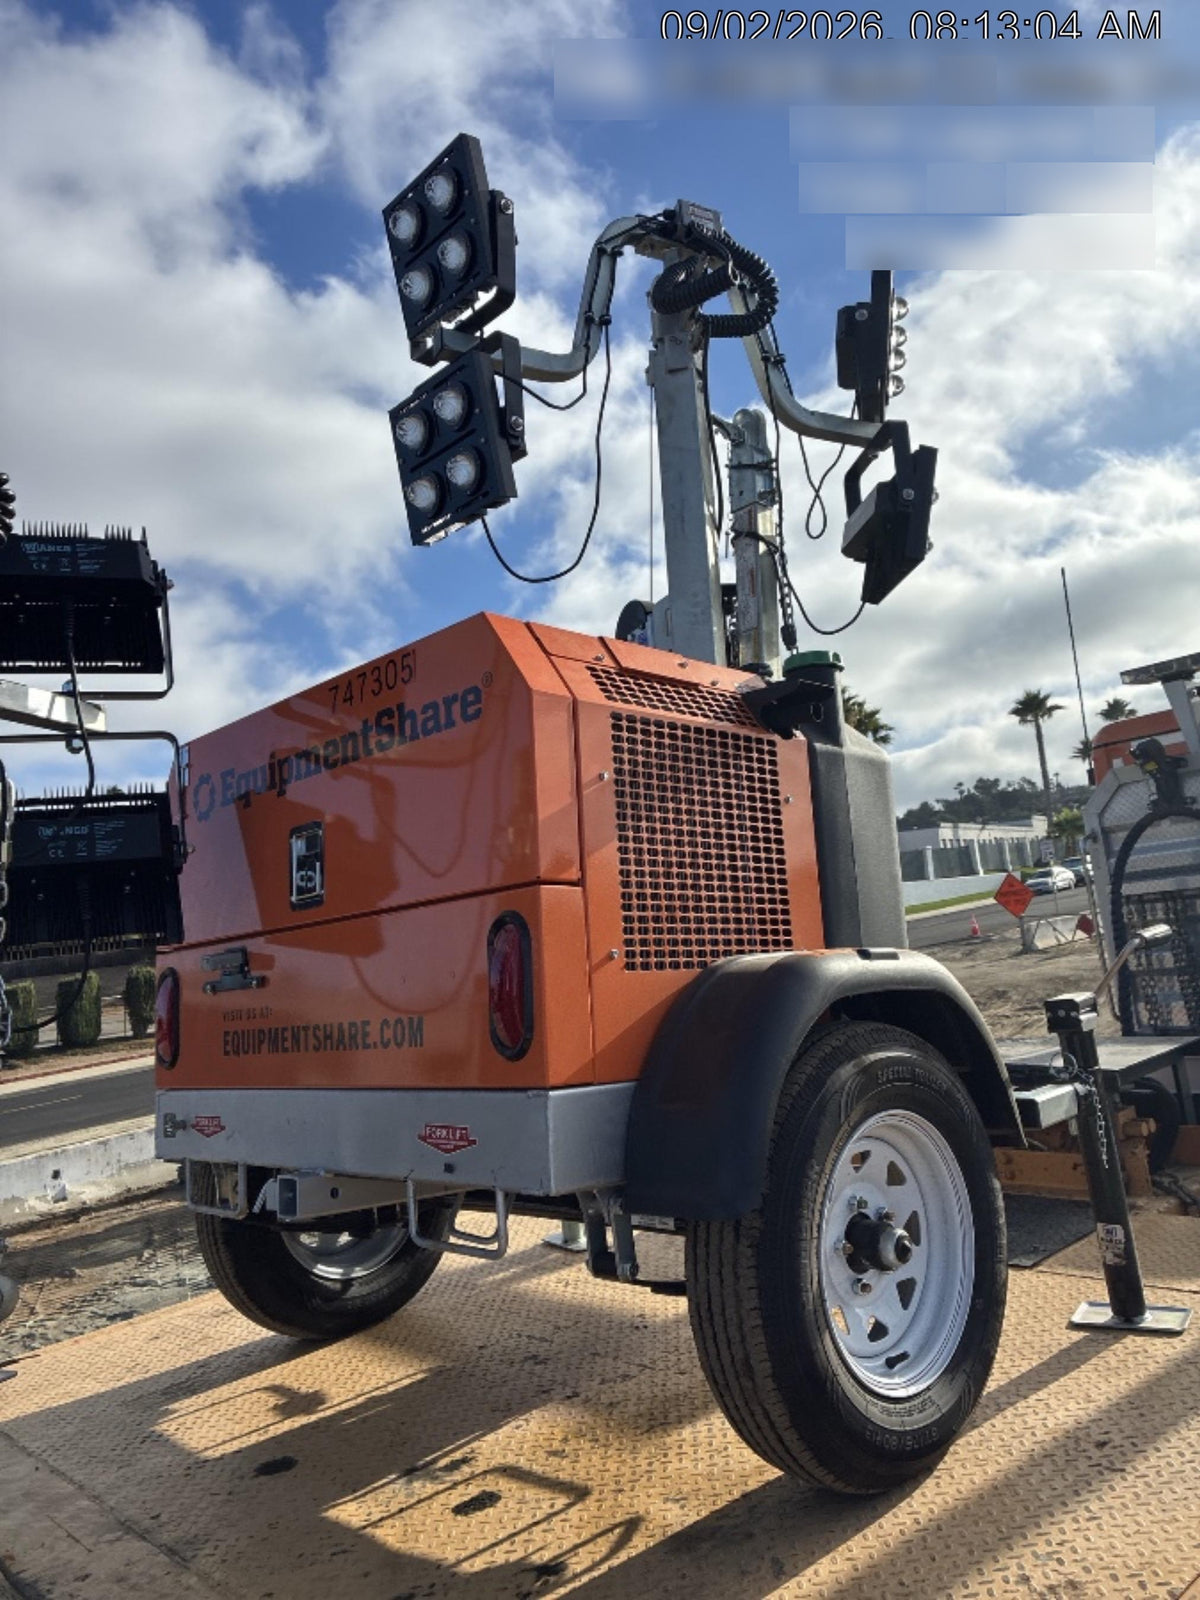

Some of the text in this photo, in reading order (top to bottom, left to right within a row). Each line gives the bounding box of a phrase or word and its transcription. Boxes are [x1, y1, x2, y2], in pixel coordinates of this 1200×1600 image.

[327, 652, 413, 715] 747305
[219, 683, 483, 809] EquipmentShare
[222, 1015, 425, 1058] EQUIPMENTSHARE.COM
